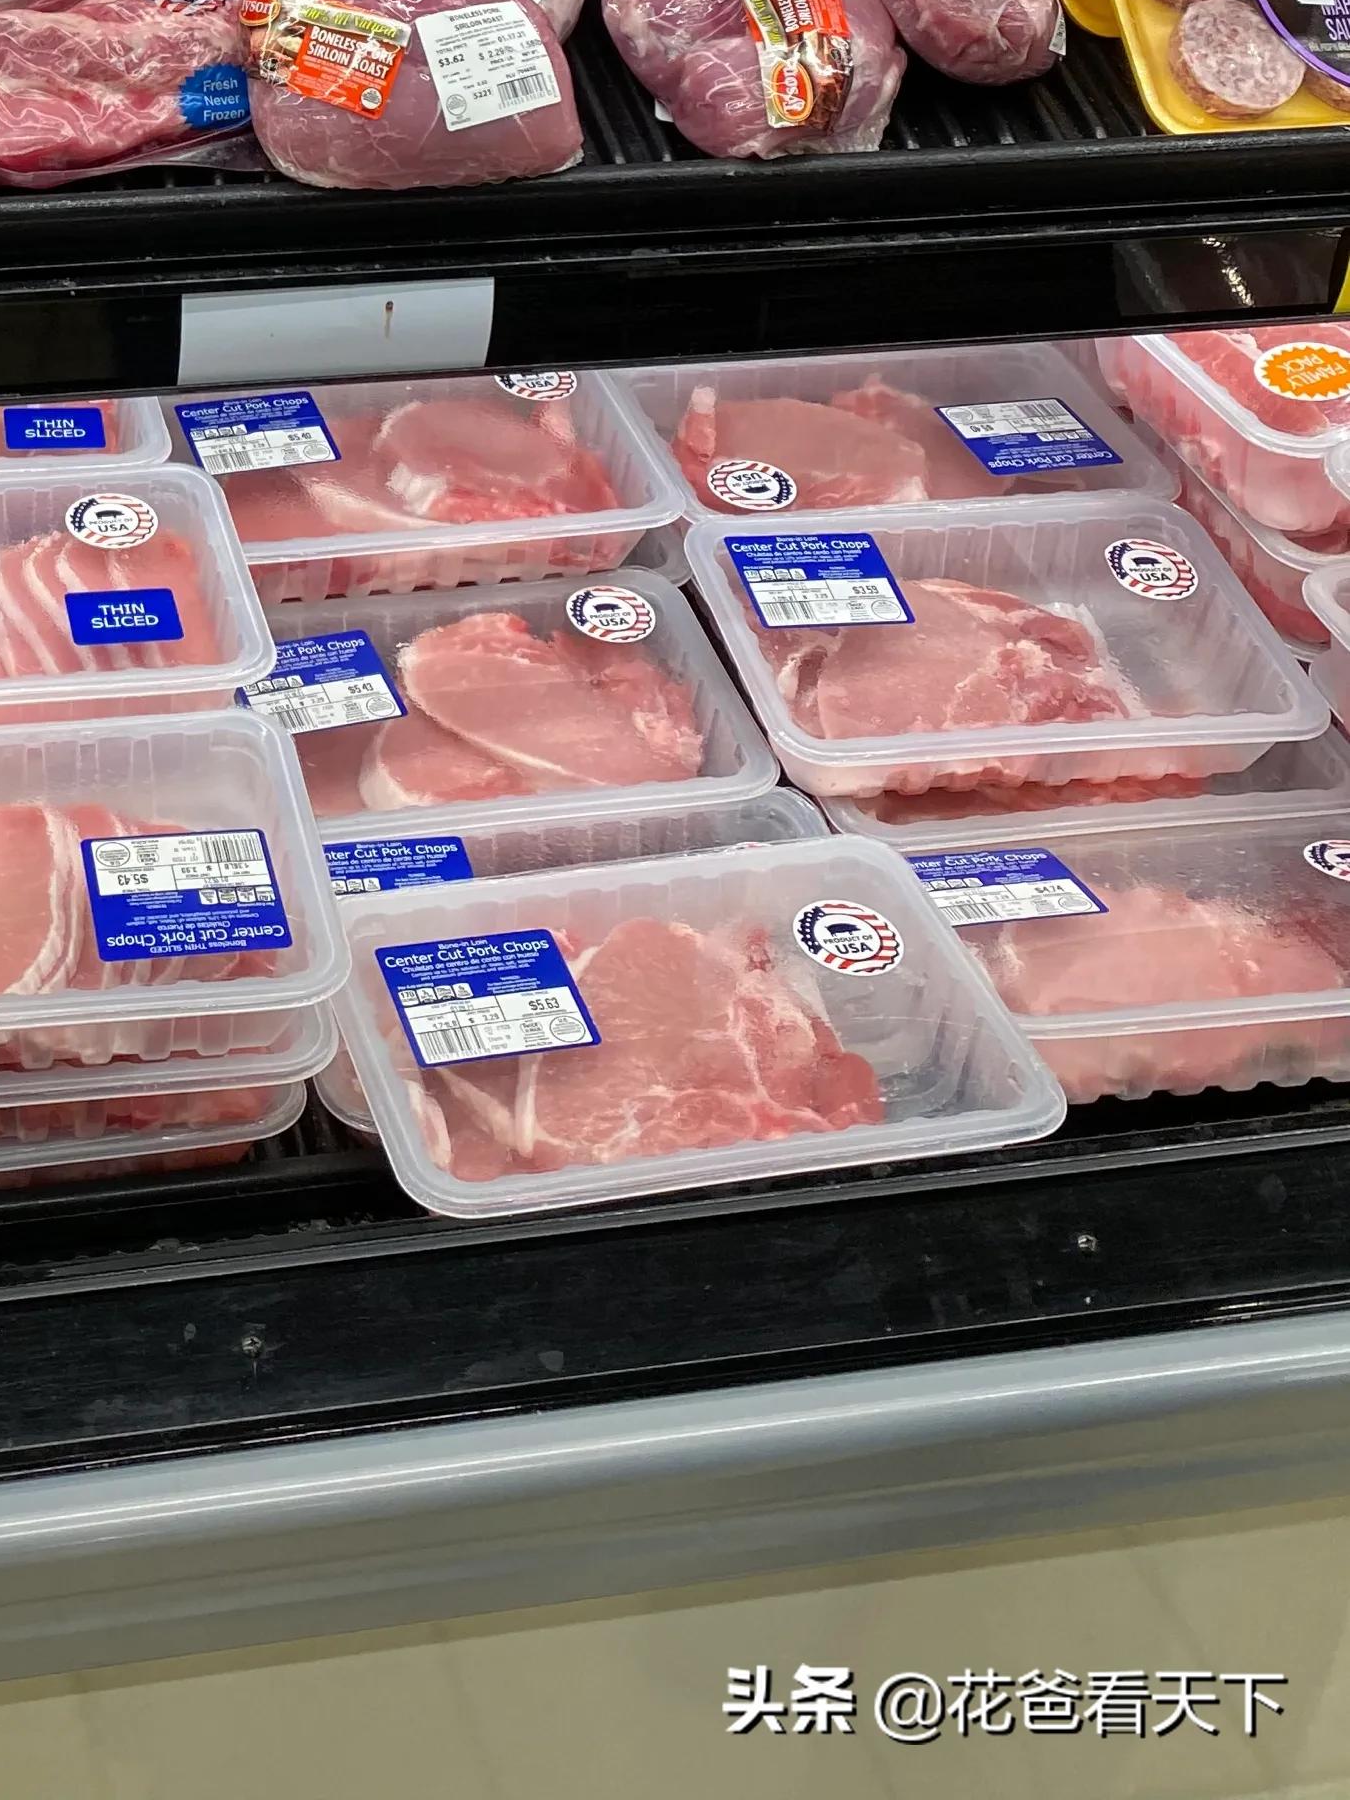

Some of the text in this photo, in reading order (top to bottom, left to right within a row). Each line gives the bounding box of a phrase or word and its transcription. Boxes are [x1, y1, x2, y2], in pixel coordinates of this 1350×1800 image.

[203, 78, 238, 92] Fresh
[203, 94, 240, 107] Never
[203, 108, 245, 122] Frozen
[33, 419, 74, 428] THIN
[25, 429, 86, 438] SLICED
[97, 523, 129, 533] USA
[732, 539, 870, 552] Center Cut Pork Chops
[1139, 572, 1171, 582] USA
[98, 603, 145, 616] THIN
[91, 615, 159, 628] SLICED
[599, 618, 629, 627] USA
[107, 924, 285, 947] Center Cut Pork Chops
[384, 938, 549, 969] Center Cut Pork Chops
[834, 942, 871, 955] USA
